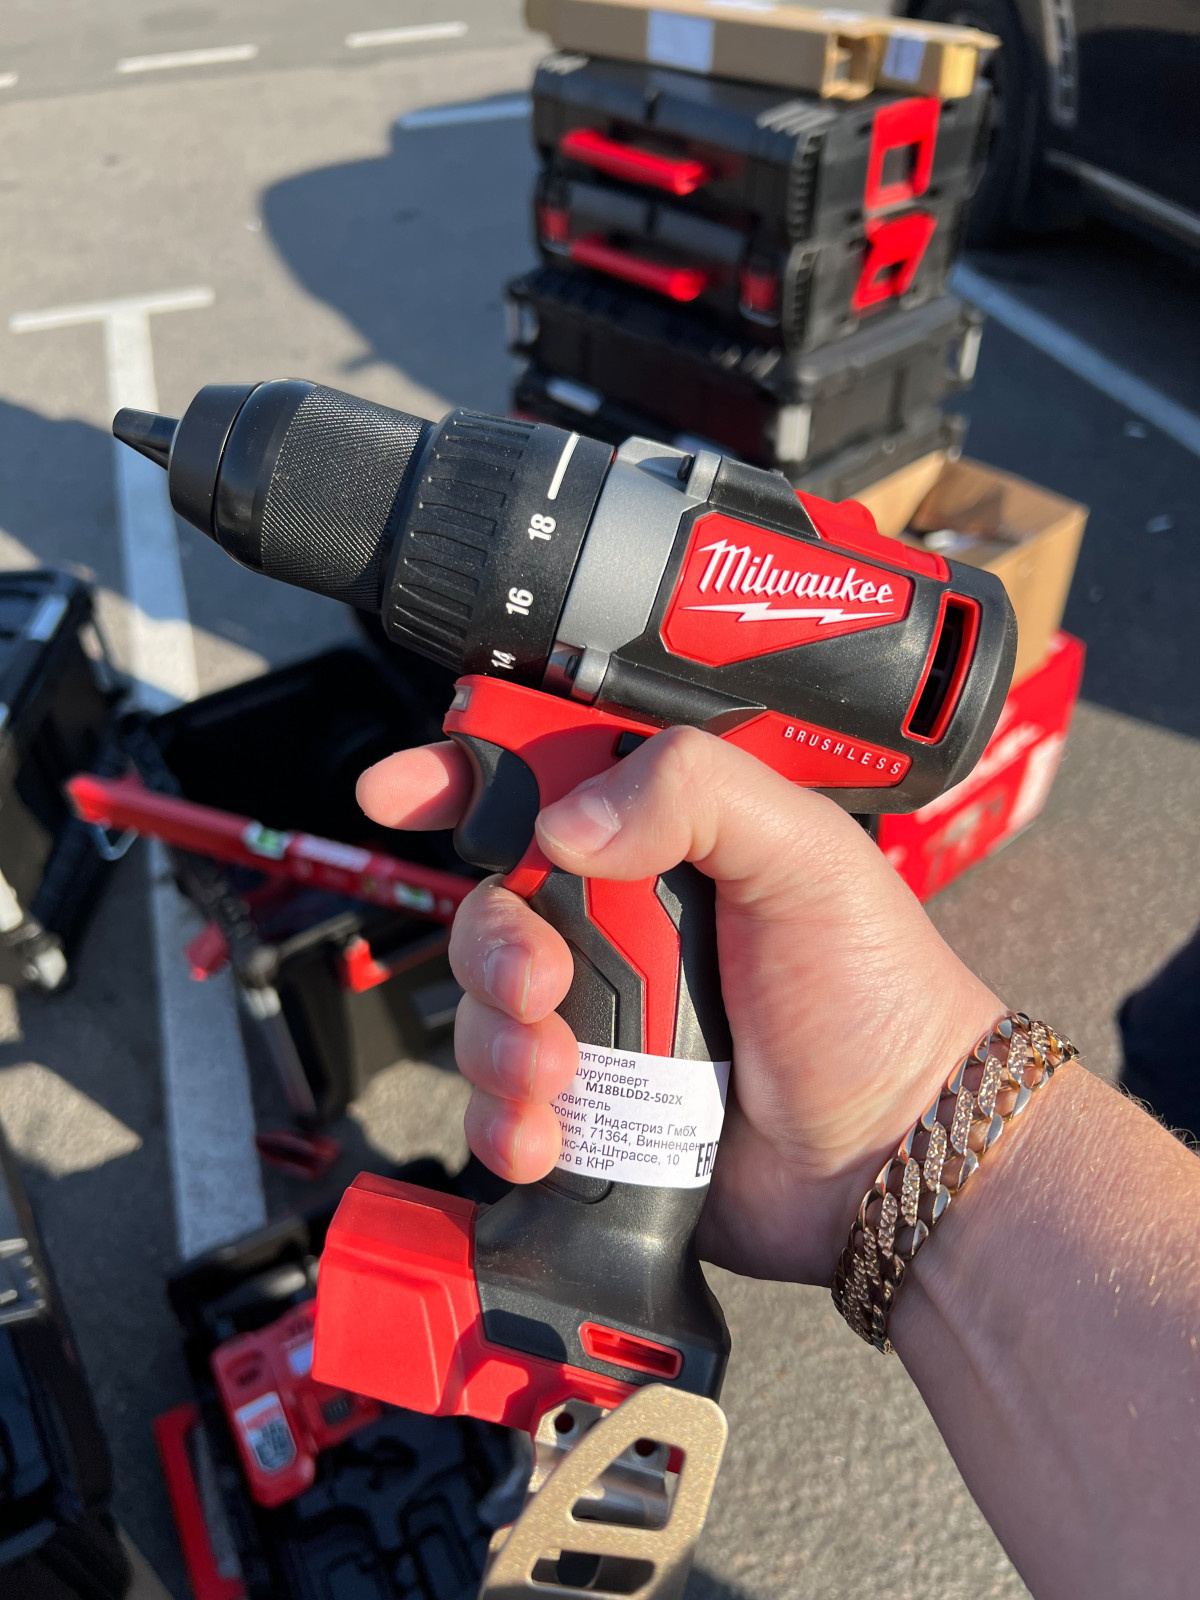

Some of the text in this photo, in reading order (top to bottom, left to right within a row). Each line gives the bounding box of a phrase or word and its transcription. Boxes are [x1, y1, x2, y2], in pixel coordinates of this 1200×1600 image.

[527, 513, 557, 542] 18
[698, 538, 894, 605] Milwaukee
[505, 586, 534, 617] 16
[490, 649, 517, 671] 14
[783, 725, 903, 776] BRUSHLESS
[585, 1081, 683, 1106] M18BLDD2-502X
[559, 1120, 585, 1139] ния,
[590, 1126, 631, 1147] 71364,
[594, 1113, 663, 1135] Индастриз
[667, 1123, 697, 1138] ГмбХ
[586, 1155, 615, 1172] КНР
[666, 1153, 680, 1166] 10
